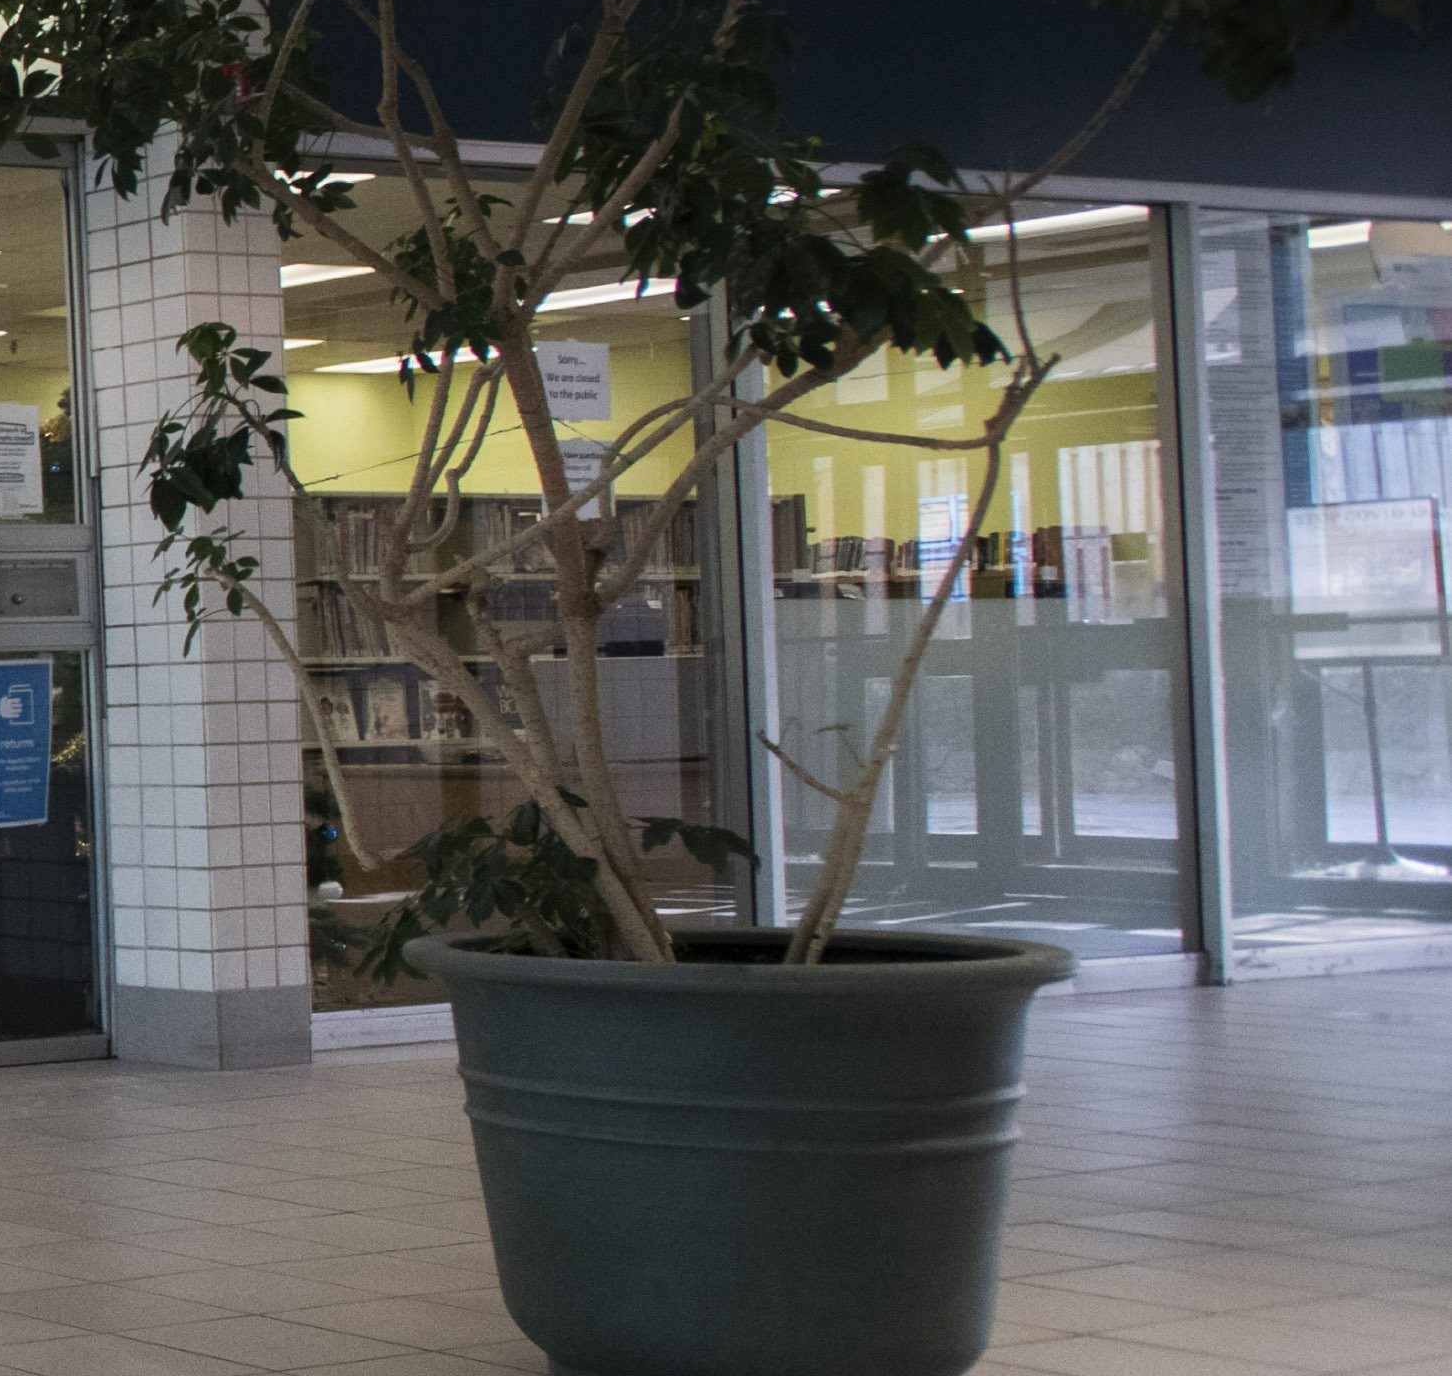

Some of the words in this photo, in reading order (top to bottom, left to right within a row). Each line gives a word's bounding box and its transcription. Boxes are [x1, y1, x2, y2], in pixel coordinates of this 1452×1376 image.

[547, 374, 560, 383] We
[561, 375, 574, 383] are
[575, 374, 600, 384] closed
[560, 390, 573, 399] the
[574, 390, 598, 401] public
[0, 738, 35, 749] returns
